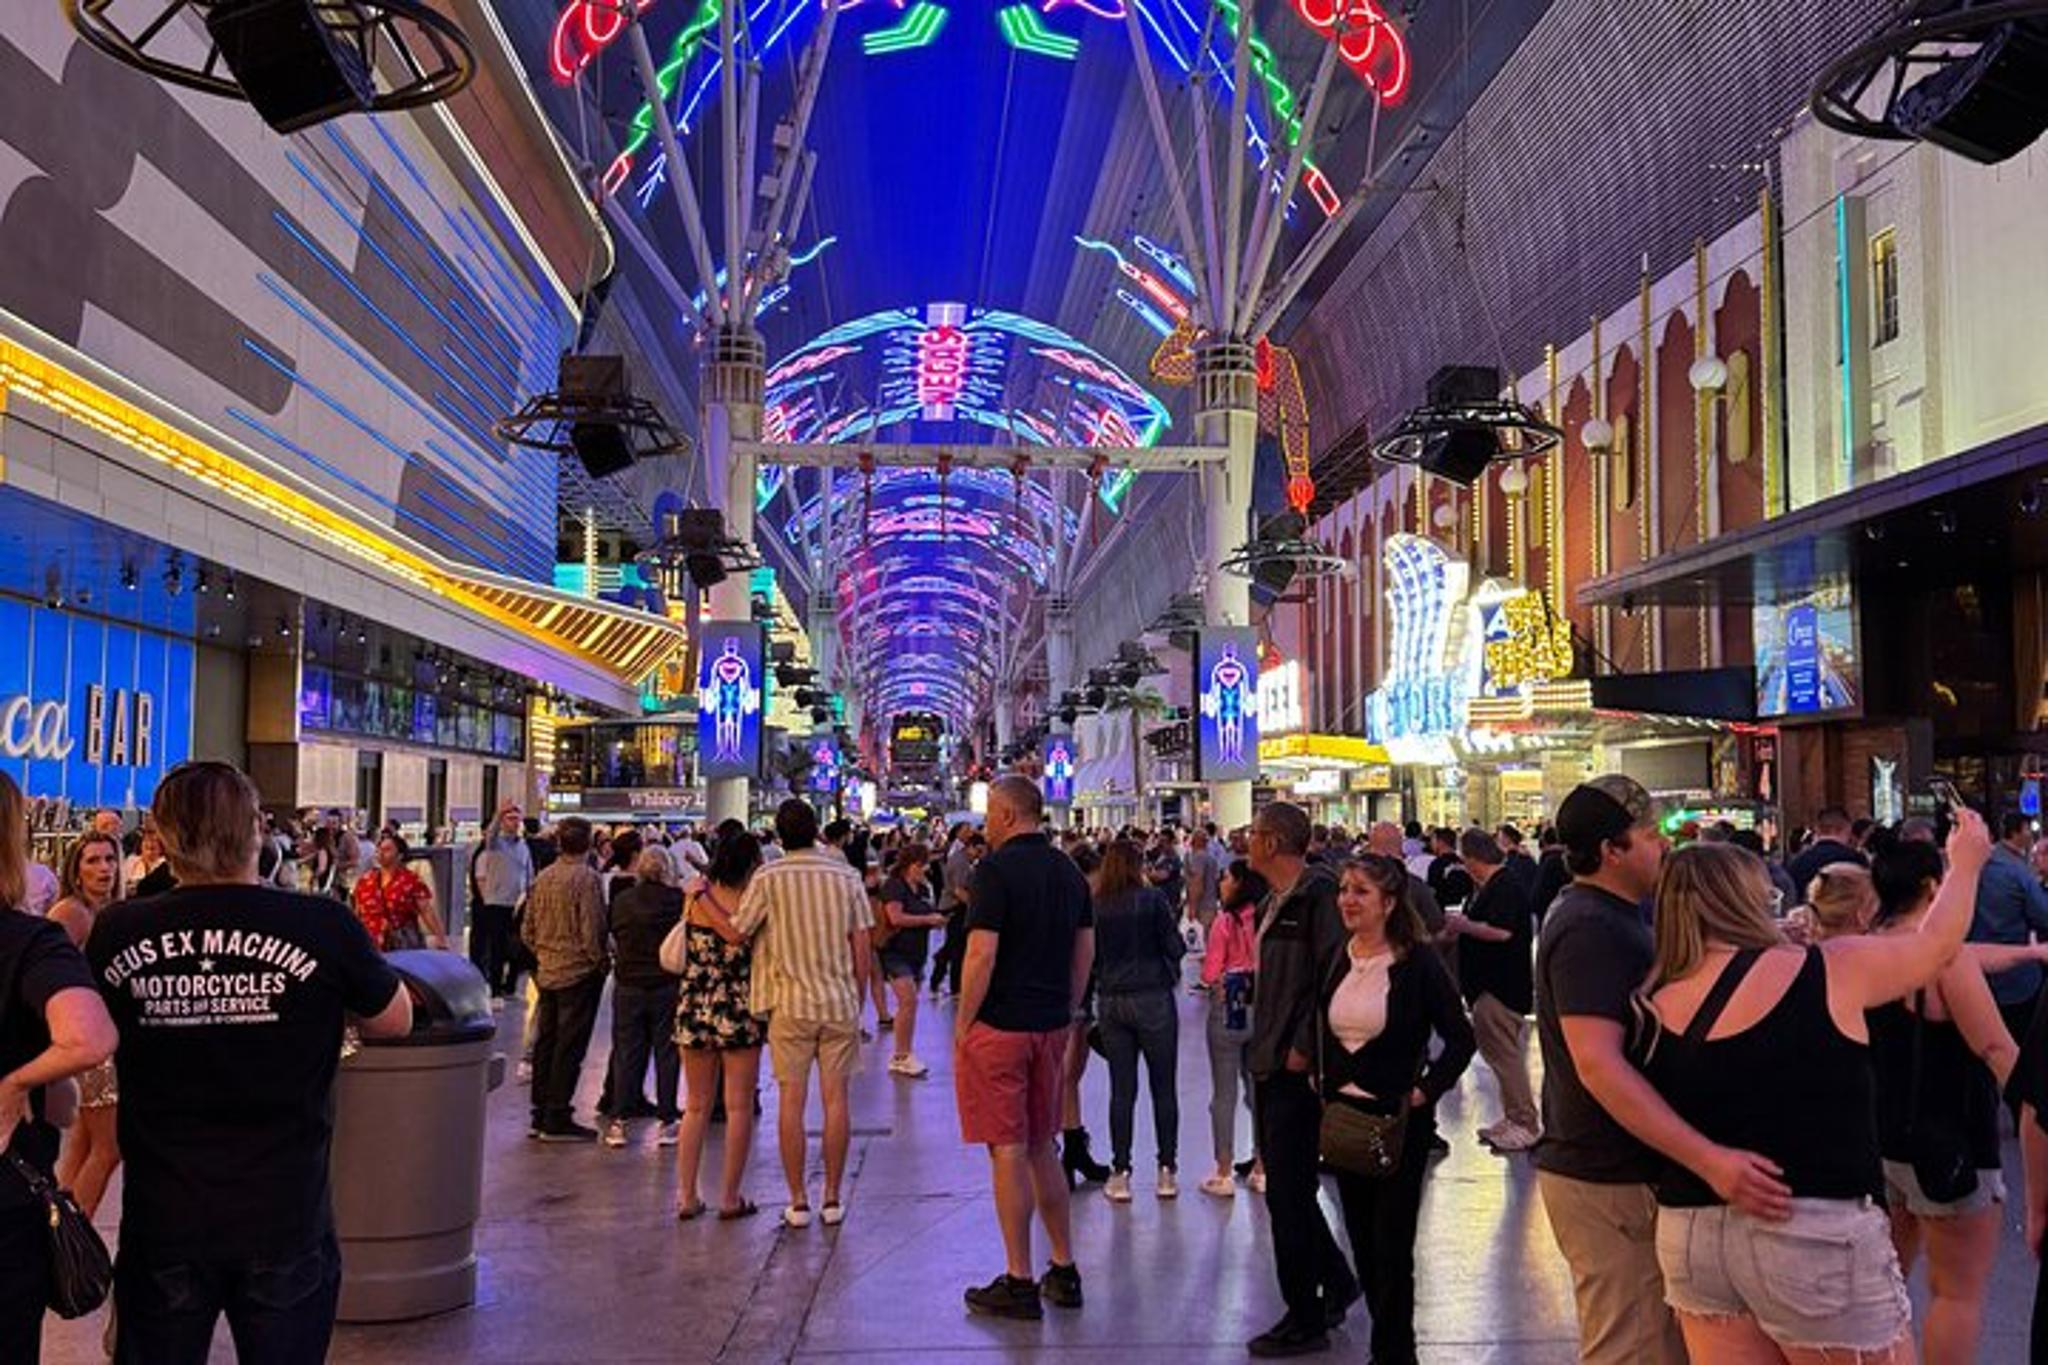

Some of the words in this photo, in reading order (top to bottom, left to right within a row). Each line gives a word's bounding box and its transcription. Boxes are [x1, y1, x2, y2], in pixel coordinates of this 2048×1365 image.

[84, 683, 153, 768] BAR
[104, 937, 158, 988] DEUS
[161, 929, 196, 959] EX
[202, 929, 319, 982] MACHINA
[130, 972, 287, 998] MOTORCYCLES
[145, 999, 191, 1015] PARTS
[210, 996, 270, 1013] SERVICE
